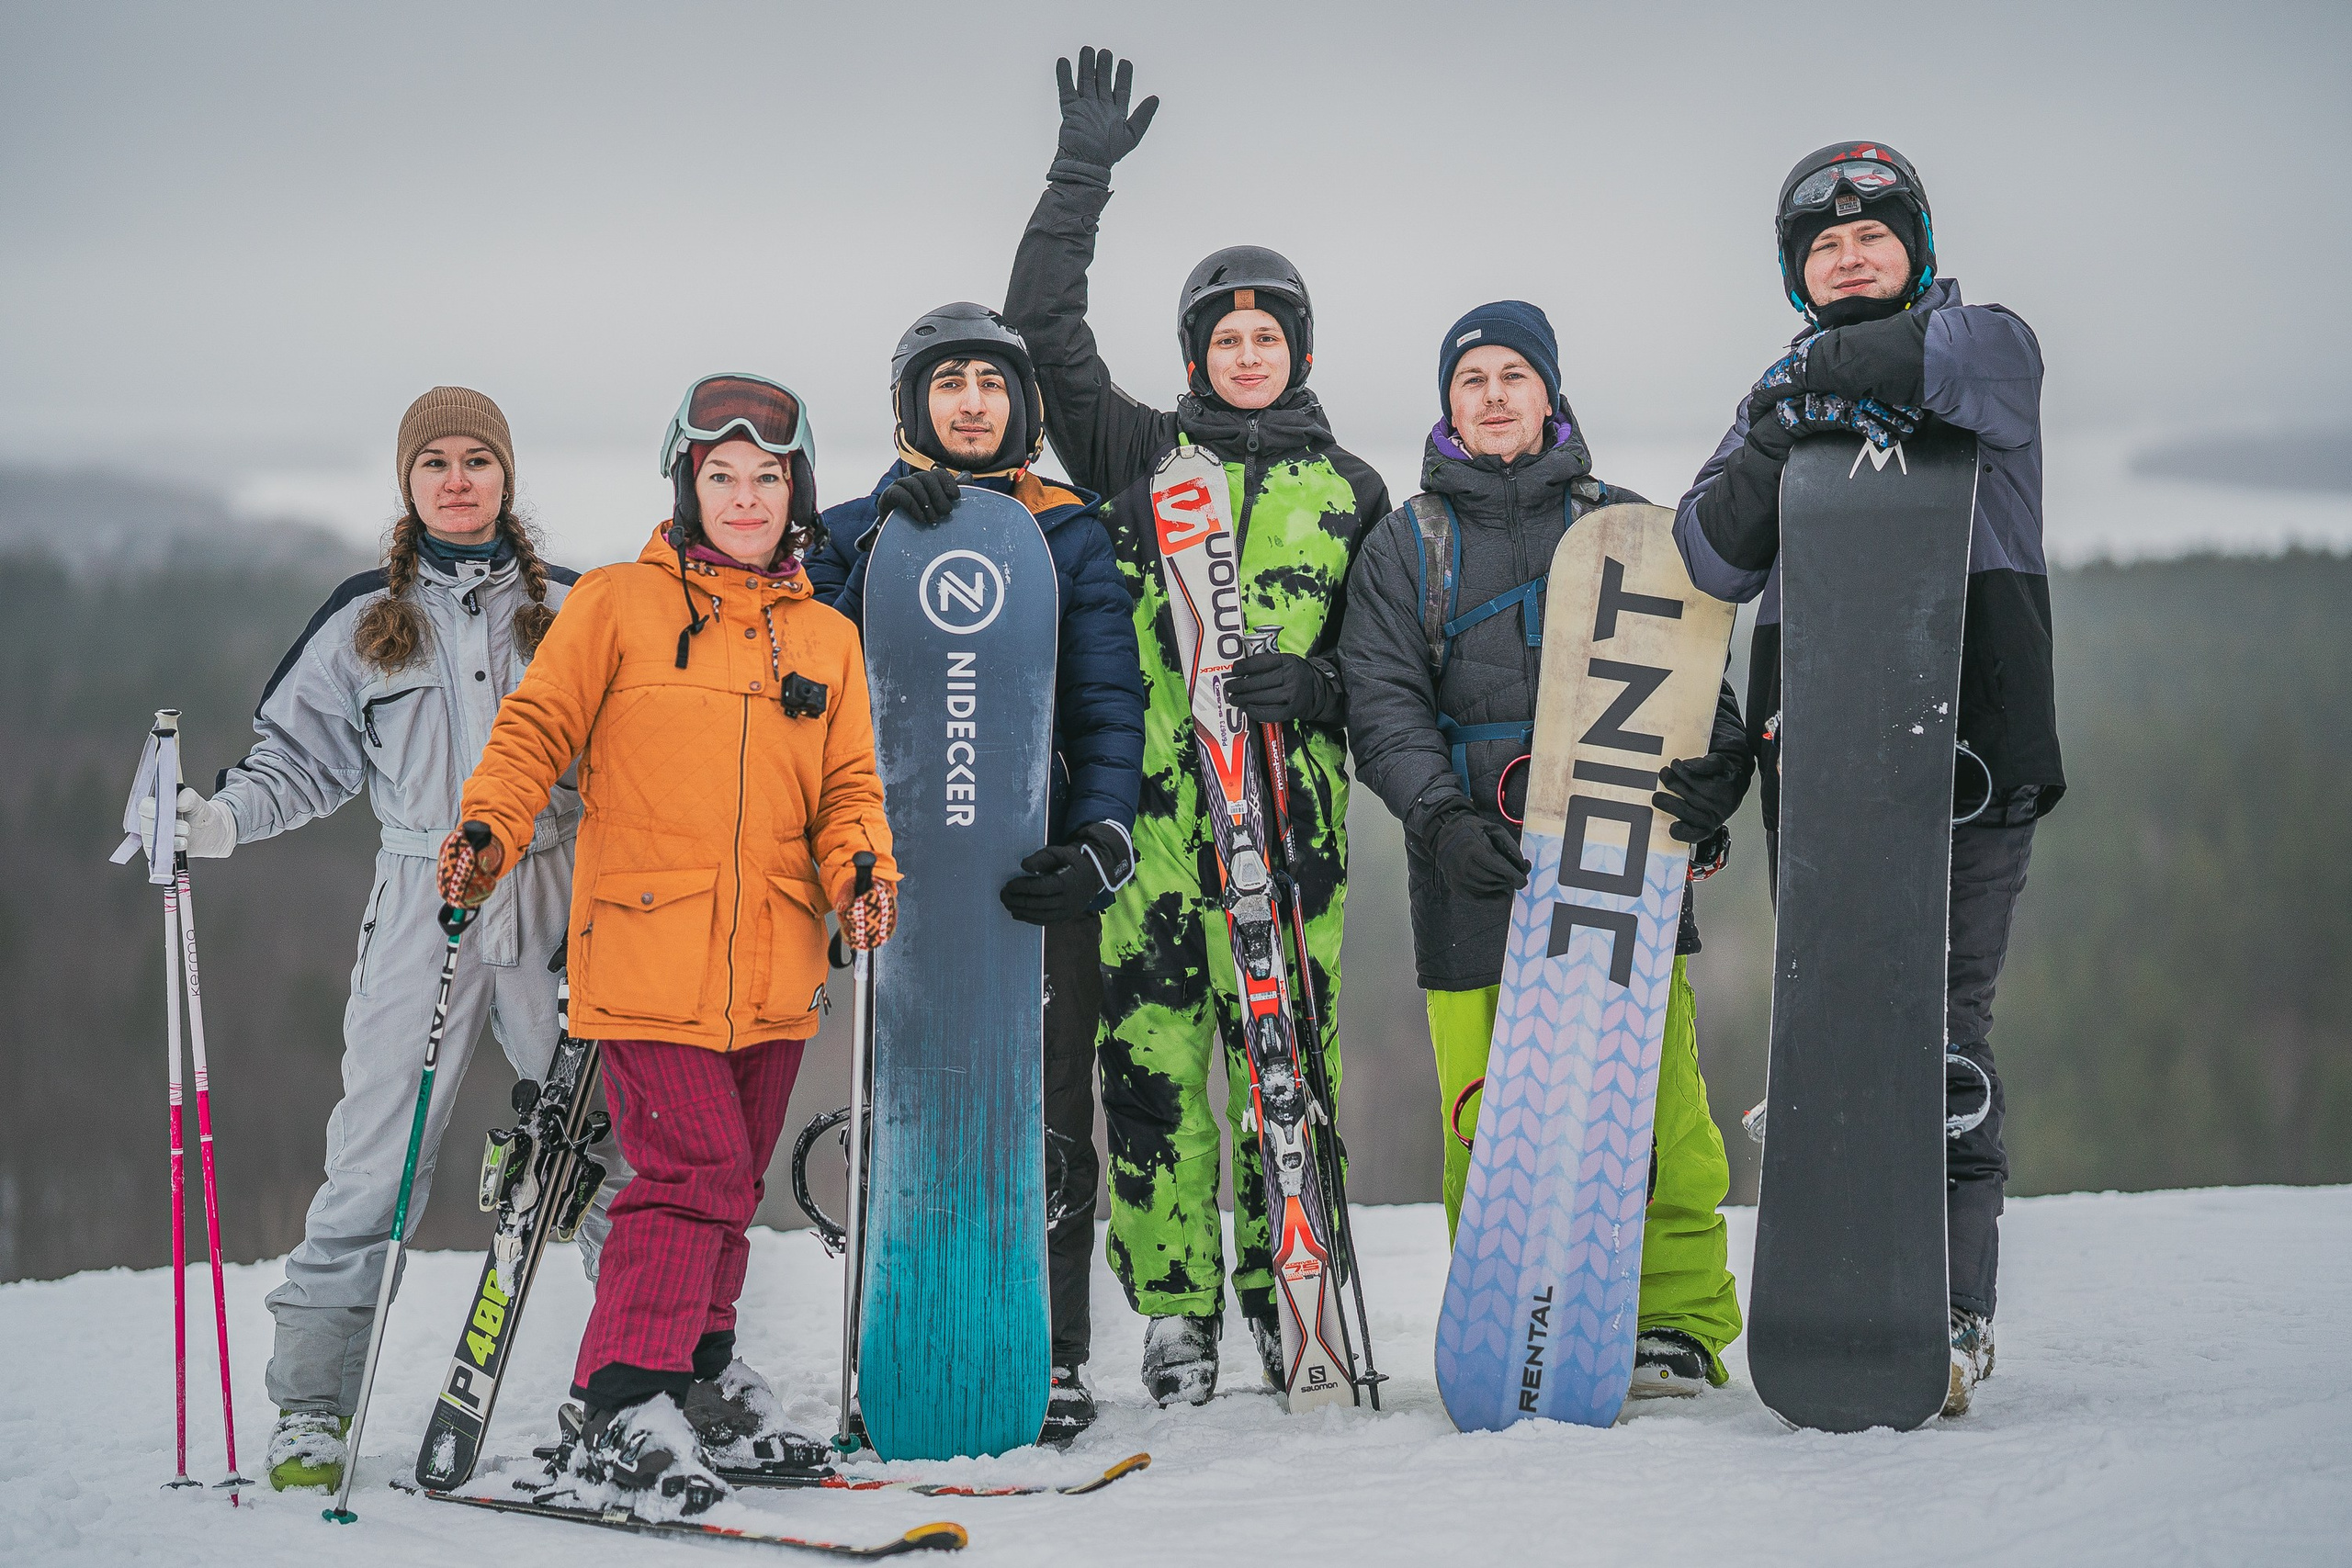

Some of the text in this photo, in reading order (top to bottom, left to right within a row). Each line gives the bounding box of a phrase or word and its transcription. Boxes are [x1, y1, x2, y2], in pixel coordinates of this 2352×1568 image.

[1200, 664, 1234, 674] XDRIV
[1204, 530, 1247, 734] slomon
[945, 652, 977, 827] NIDECKER
[1546, 556, 1685, 988] JOINT
[187, 930, 200, 997] kerma
[448, 1365, 481, 1410] P
[1301, 1382, 1339, 1393] salomon
[1519, 1286, 1555, 1413] RENTAL
